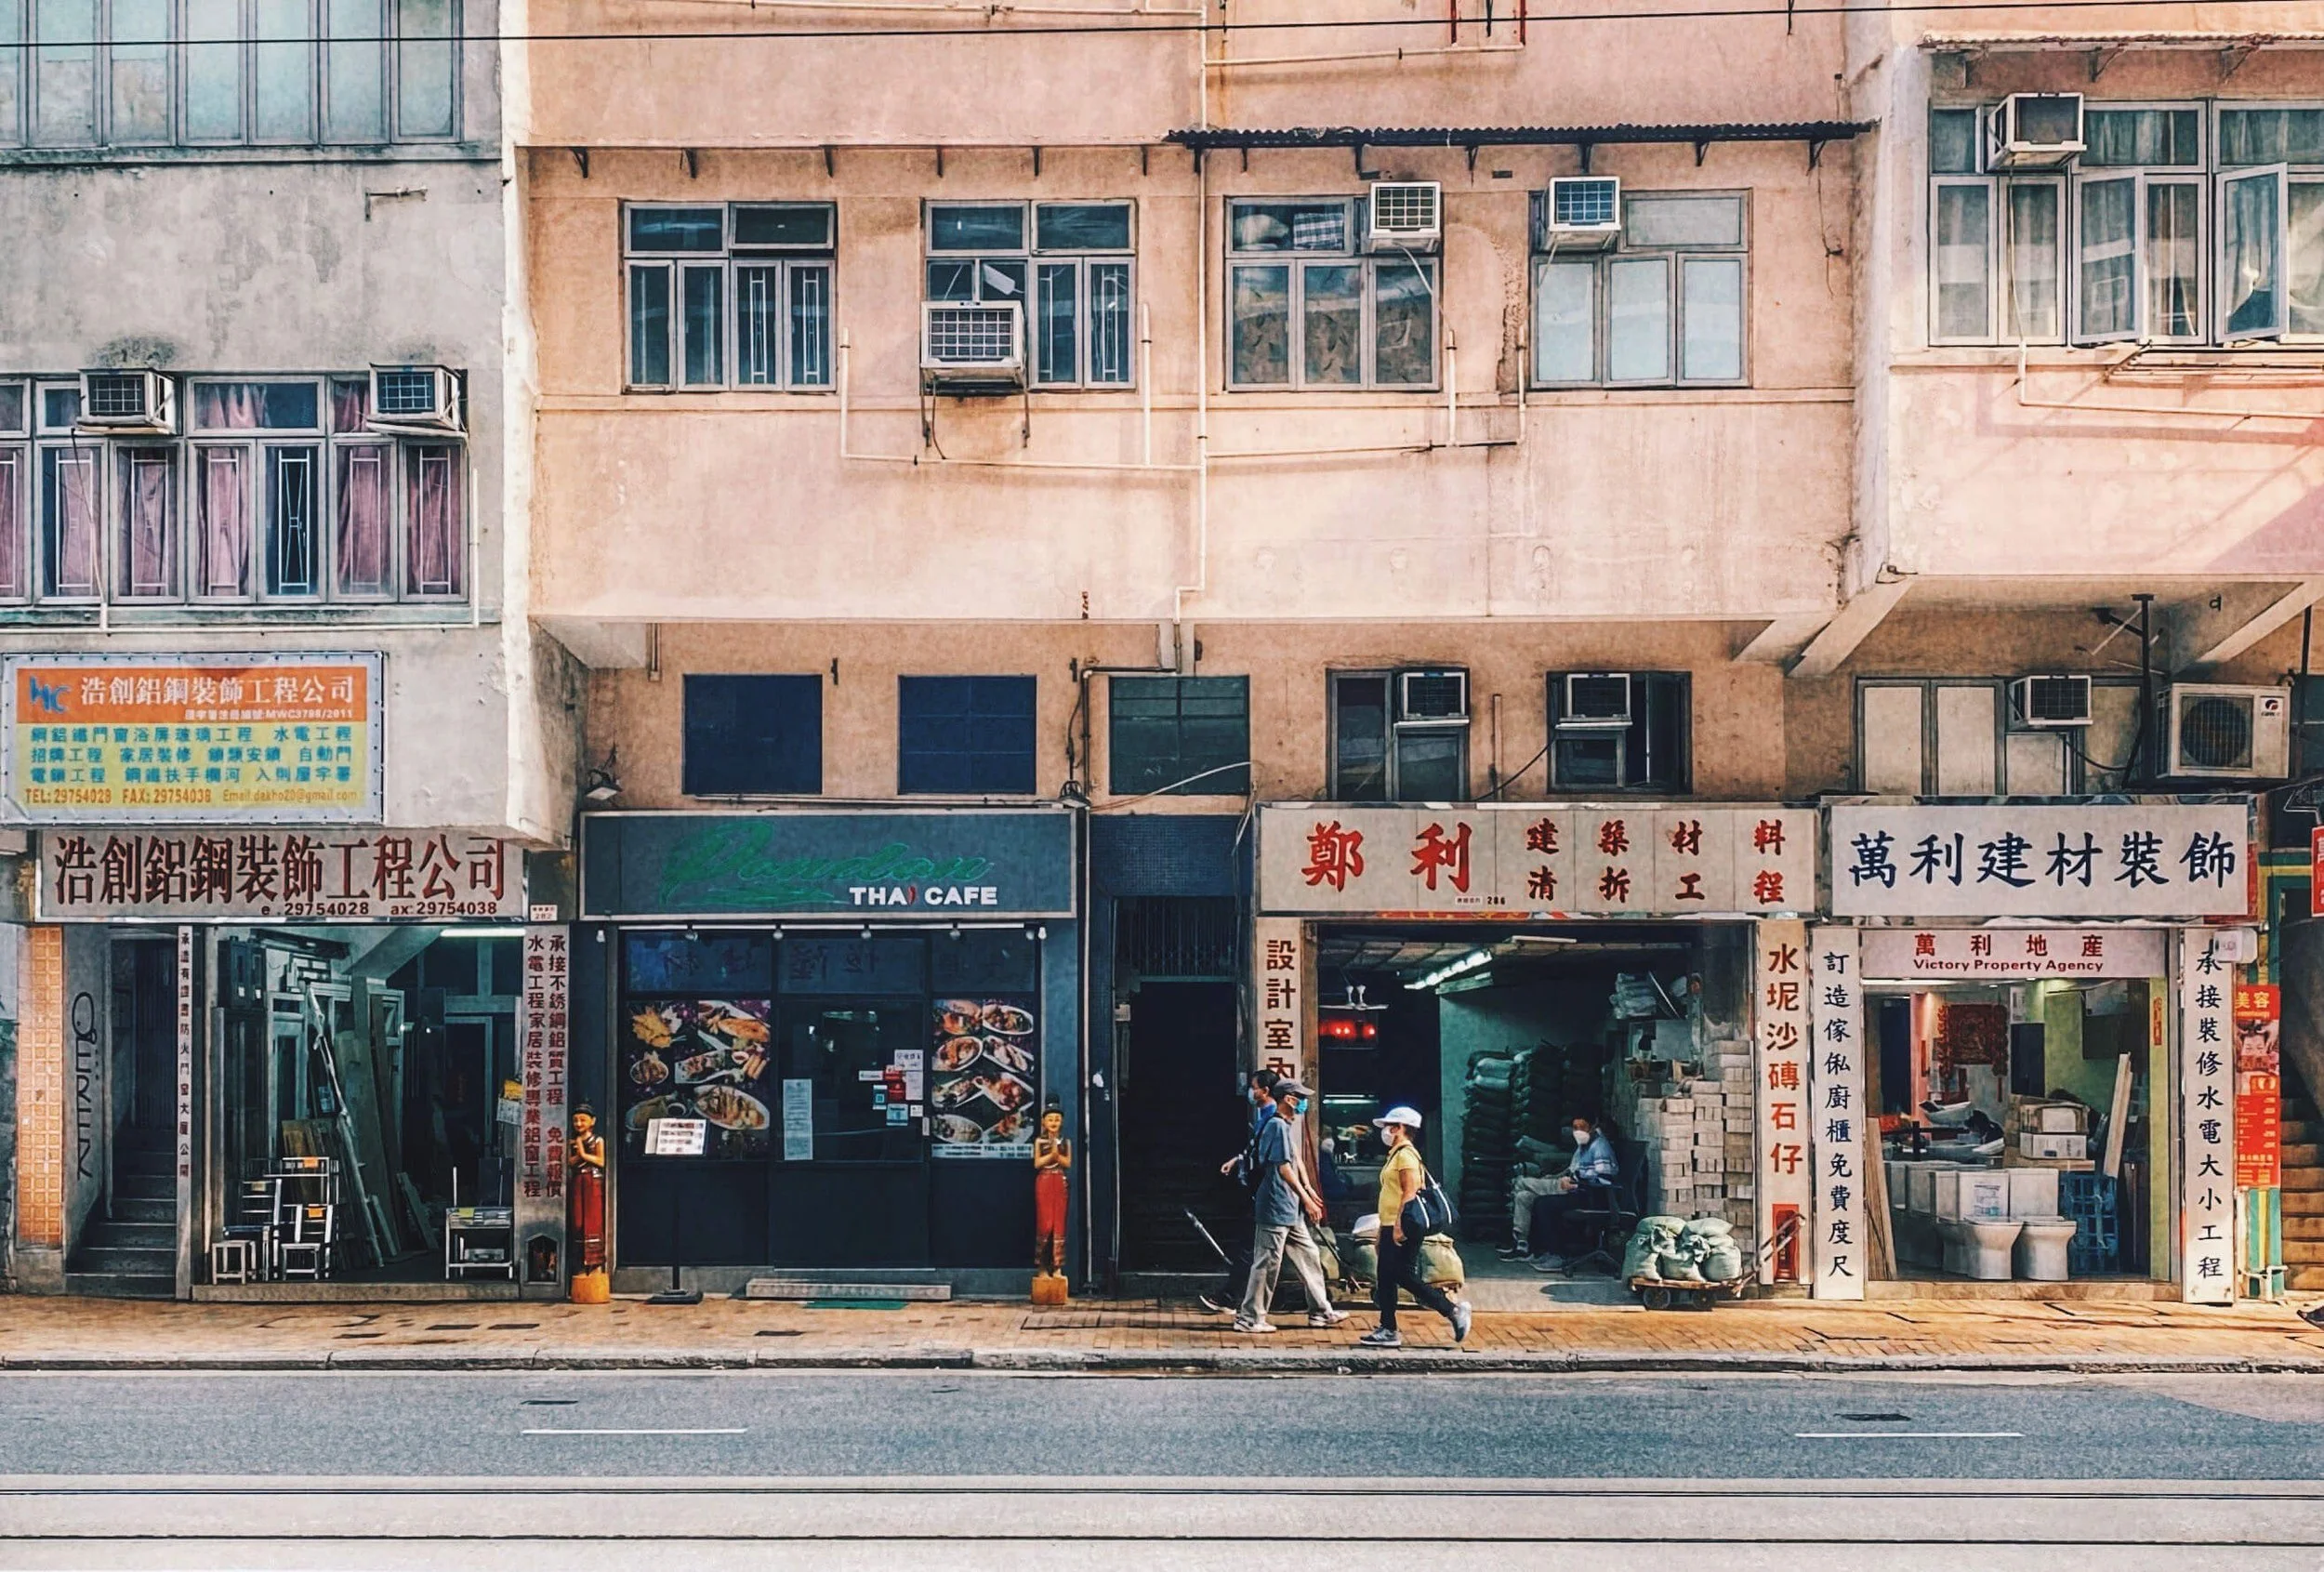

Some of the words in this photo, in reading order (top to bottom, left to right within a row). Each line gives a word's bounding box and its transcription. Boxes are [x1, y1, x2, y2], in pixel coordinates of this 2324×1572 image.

[81, 676, 354, 706] 浩創鋁鋼裝飾工程公司
[298, 746, 352, 763] 自動門
[1301, 820, 1472, 892] 鄭利
[1525, 817, 1786, 857] 建築材料
[1848, 830, 2236, 890] 萬利建材裝飾
[54, 833, 505, 905] 浩創鋁鋼裝飾工程公司
[1526, 865, 1786, 905] 清拆工程
[924, 886, 998, 905] CAFE
[1914, 958, 1970, 971] Victory
[1974, 958, 2041, 972] Property
[2046, 958, 2104, 972] Agency
[1765, 942, 1803, 1176] 水坭沙磚石仔
[1822, 950, 1854, 1278] 訂造傢俬廚櫃免費度尺
[2194, 938, 2225, 1280] 承接裝修水電大小工程
